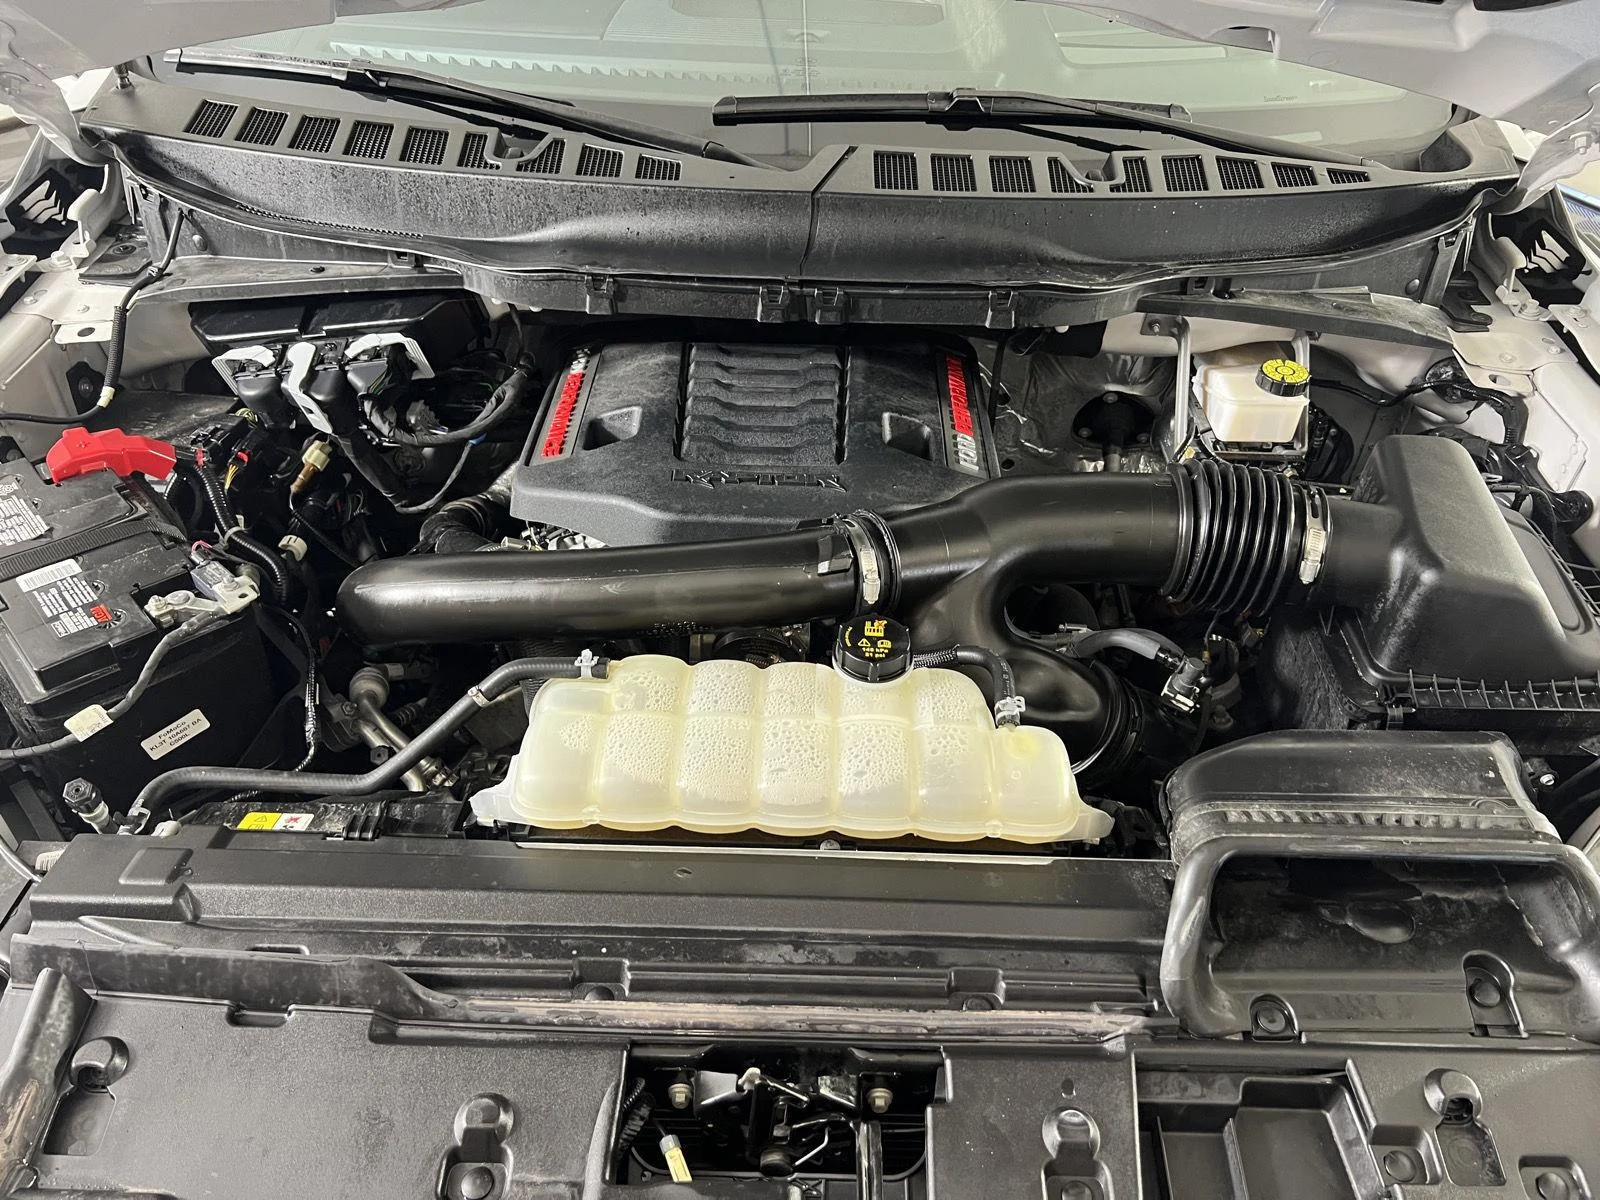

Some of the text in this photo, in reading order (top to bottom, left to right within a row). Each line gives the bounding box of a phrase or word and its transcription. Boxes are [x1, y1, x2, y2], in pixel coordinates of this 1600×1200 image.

[956, 432, 980, 471] FORD
[89, 604, 109, 623] AGM
[158, 721, 186, 739] FoMoCo
